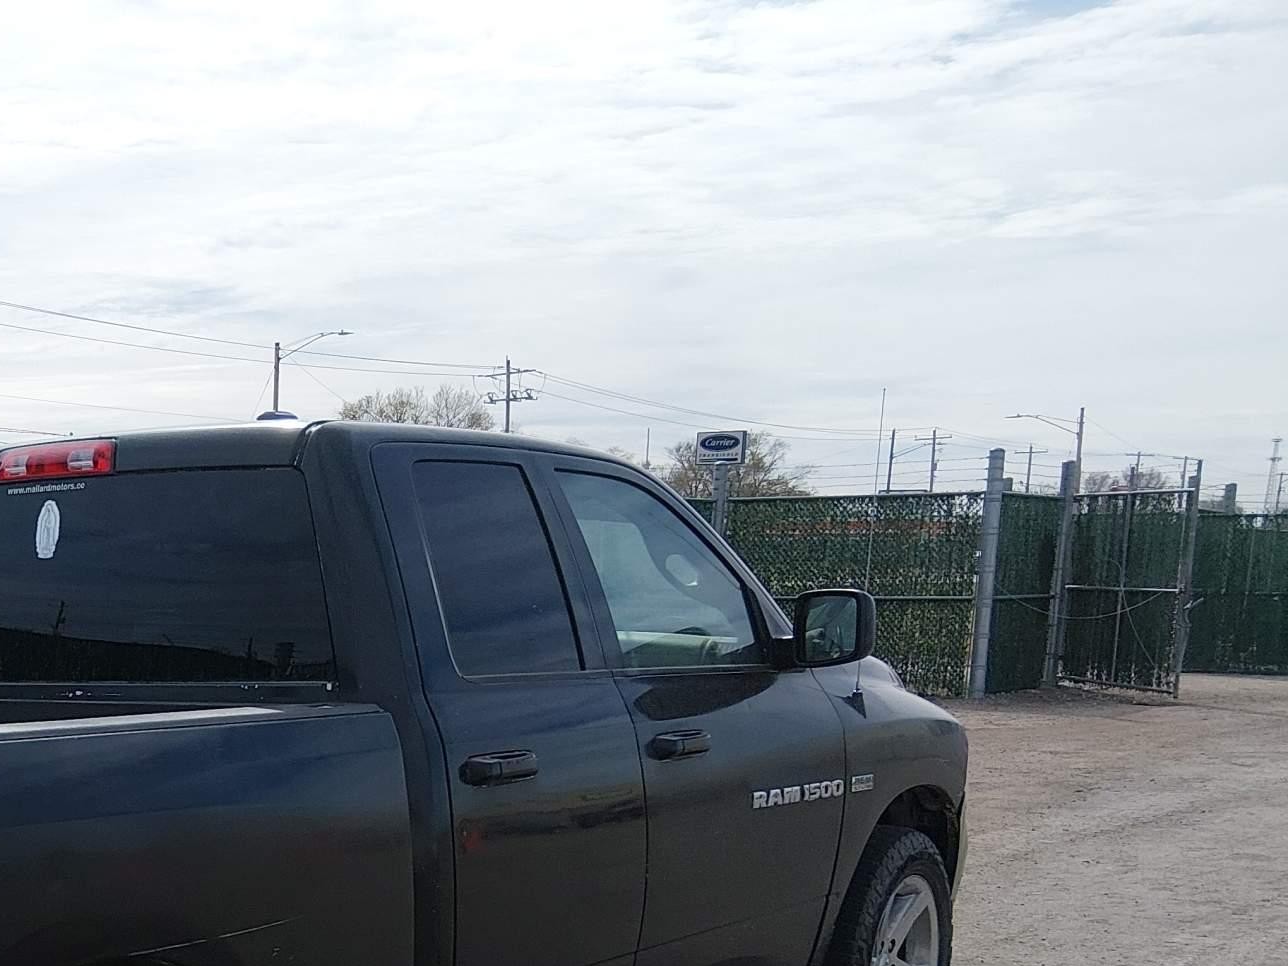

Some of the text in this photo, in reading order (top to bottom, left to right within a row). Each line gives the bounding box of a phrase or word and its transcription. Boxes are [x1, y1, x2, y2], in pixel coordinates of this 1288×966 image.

[705, 438, 736, 447] Carrier
[752, 779, 844, 809] RAM 1500
